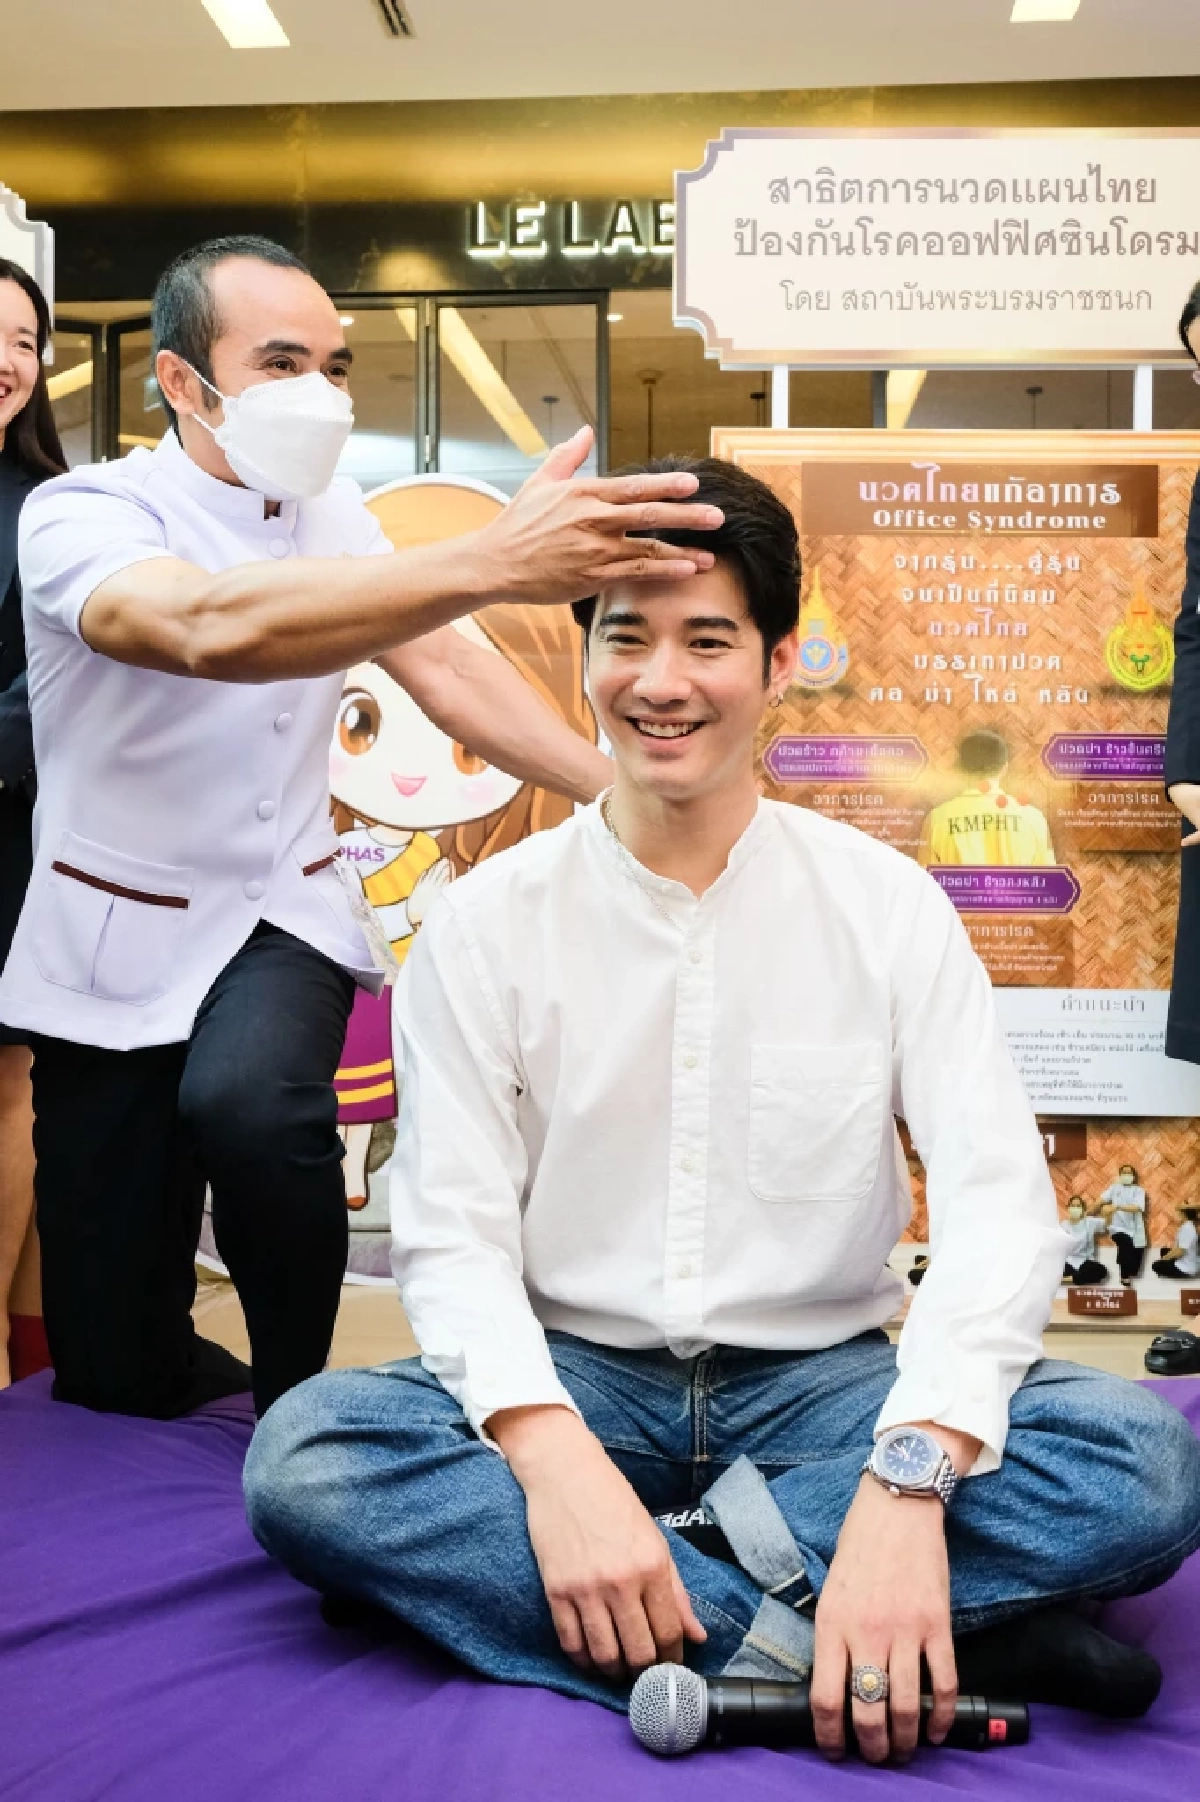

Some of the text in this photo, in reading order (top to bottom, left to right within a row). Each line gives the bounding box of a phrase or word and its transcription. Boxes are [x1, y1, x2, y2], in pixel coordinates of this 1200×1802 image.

[768, 162, 1157, 204] สาธิตการนวดแผนไทย
[465, 199, 546, 259] LE
[733, 215, 1200, 258] ป้องกันโรคออฟฟิศซินโดรม
[780, 279, 1153, 311] โดย สถาบันพระบรมราชชนก
[873, 509, 1107, 532] Office Syndrome
[929, 607, 1029, 636] นวดไทย
[914, 652, 1062, 672] บรรเทาปวด
[947, 813, 1022, 835] KMPHT
